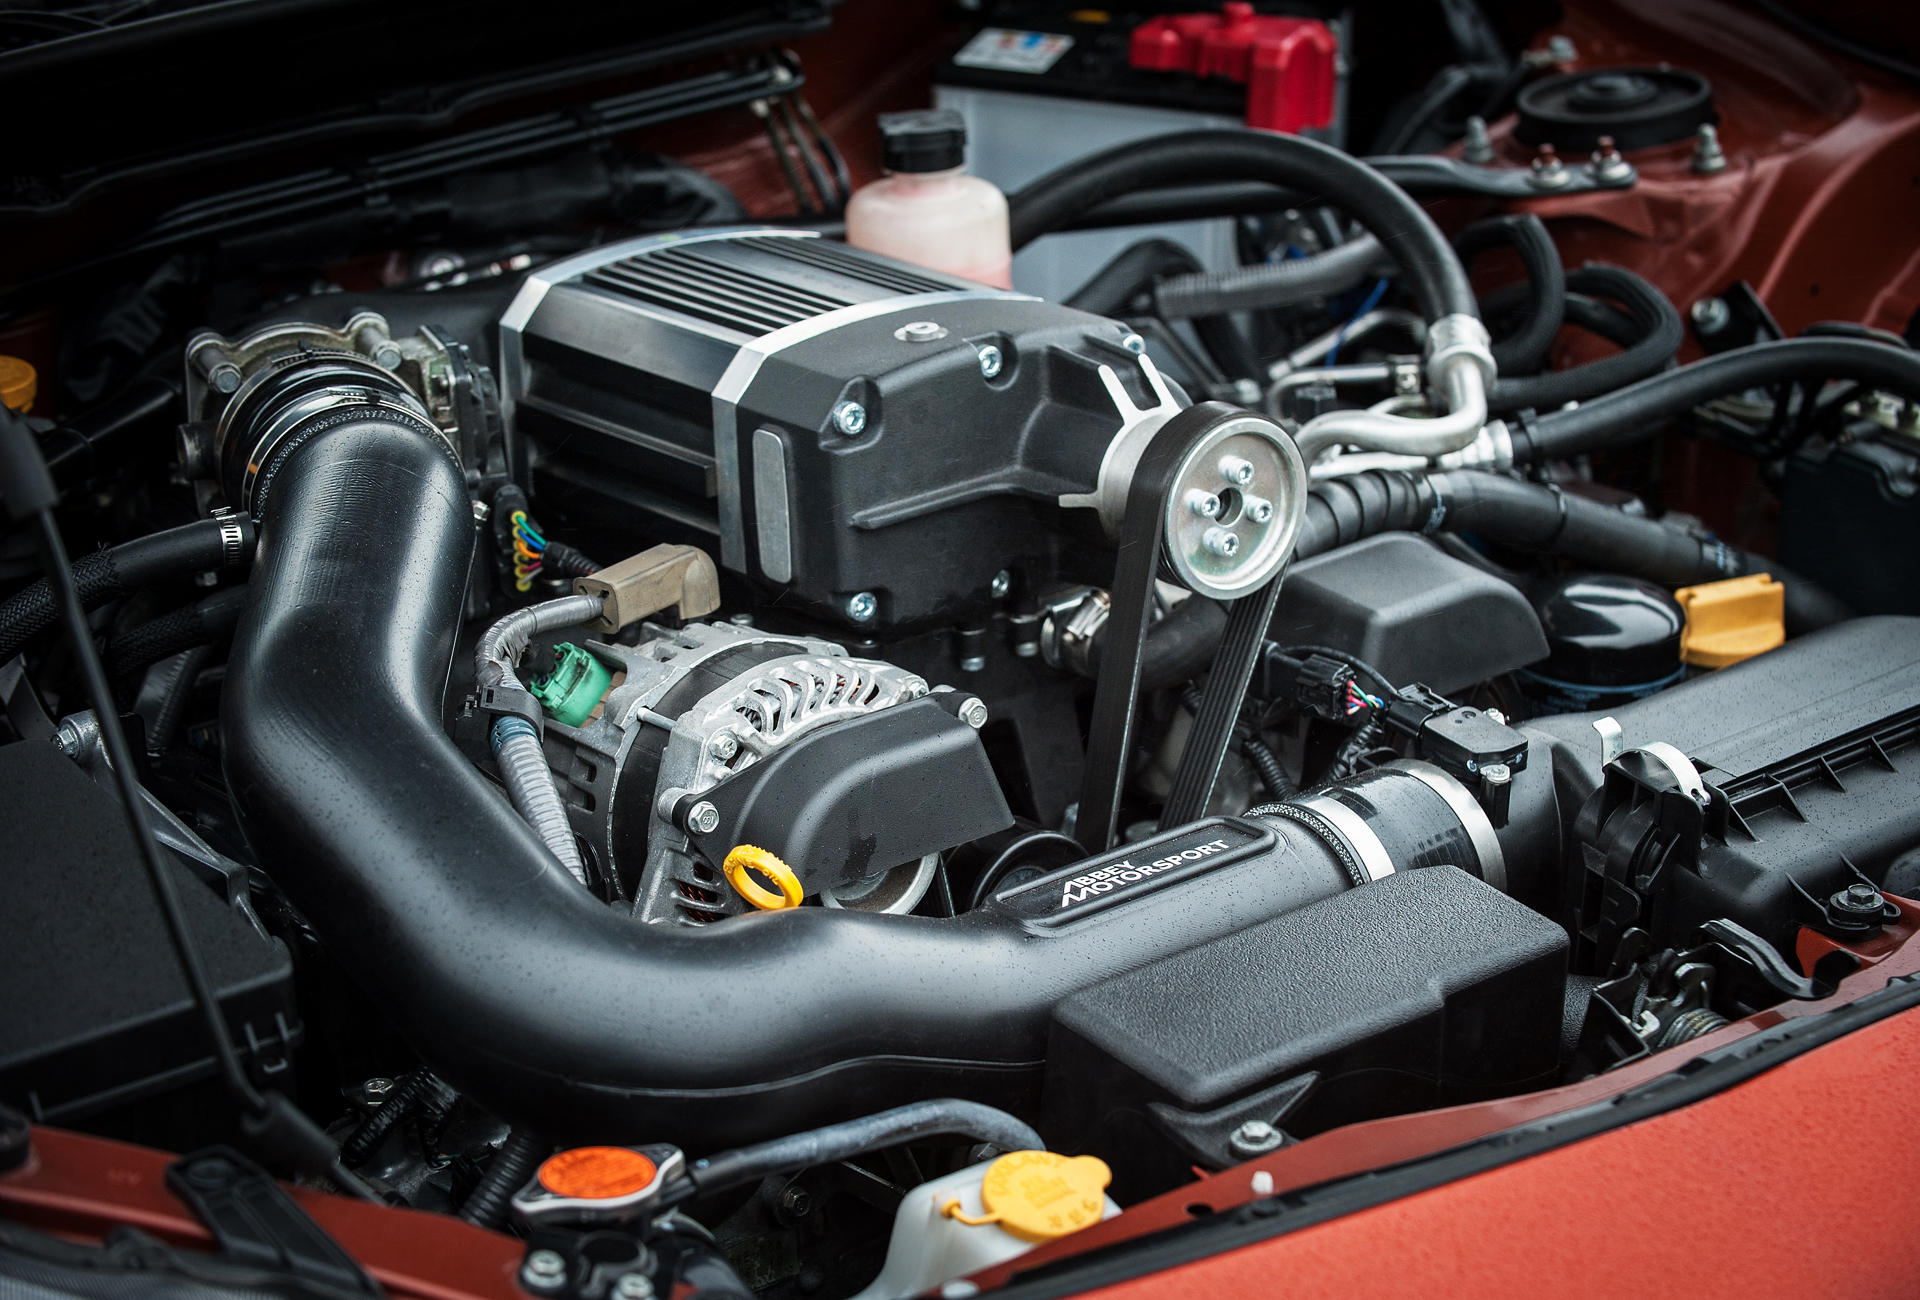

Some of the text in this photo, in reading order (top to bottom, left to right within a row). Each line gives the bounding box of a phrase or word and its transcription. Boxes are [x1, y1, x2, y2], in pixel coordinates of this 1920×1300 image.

[1061, 839, 1230, 908] MOTORSPORT
[1063, 860, 1136, 894] ABBEY
[989, 1153, 1067, 1197] COOLANT
